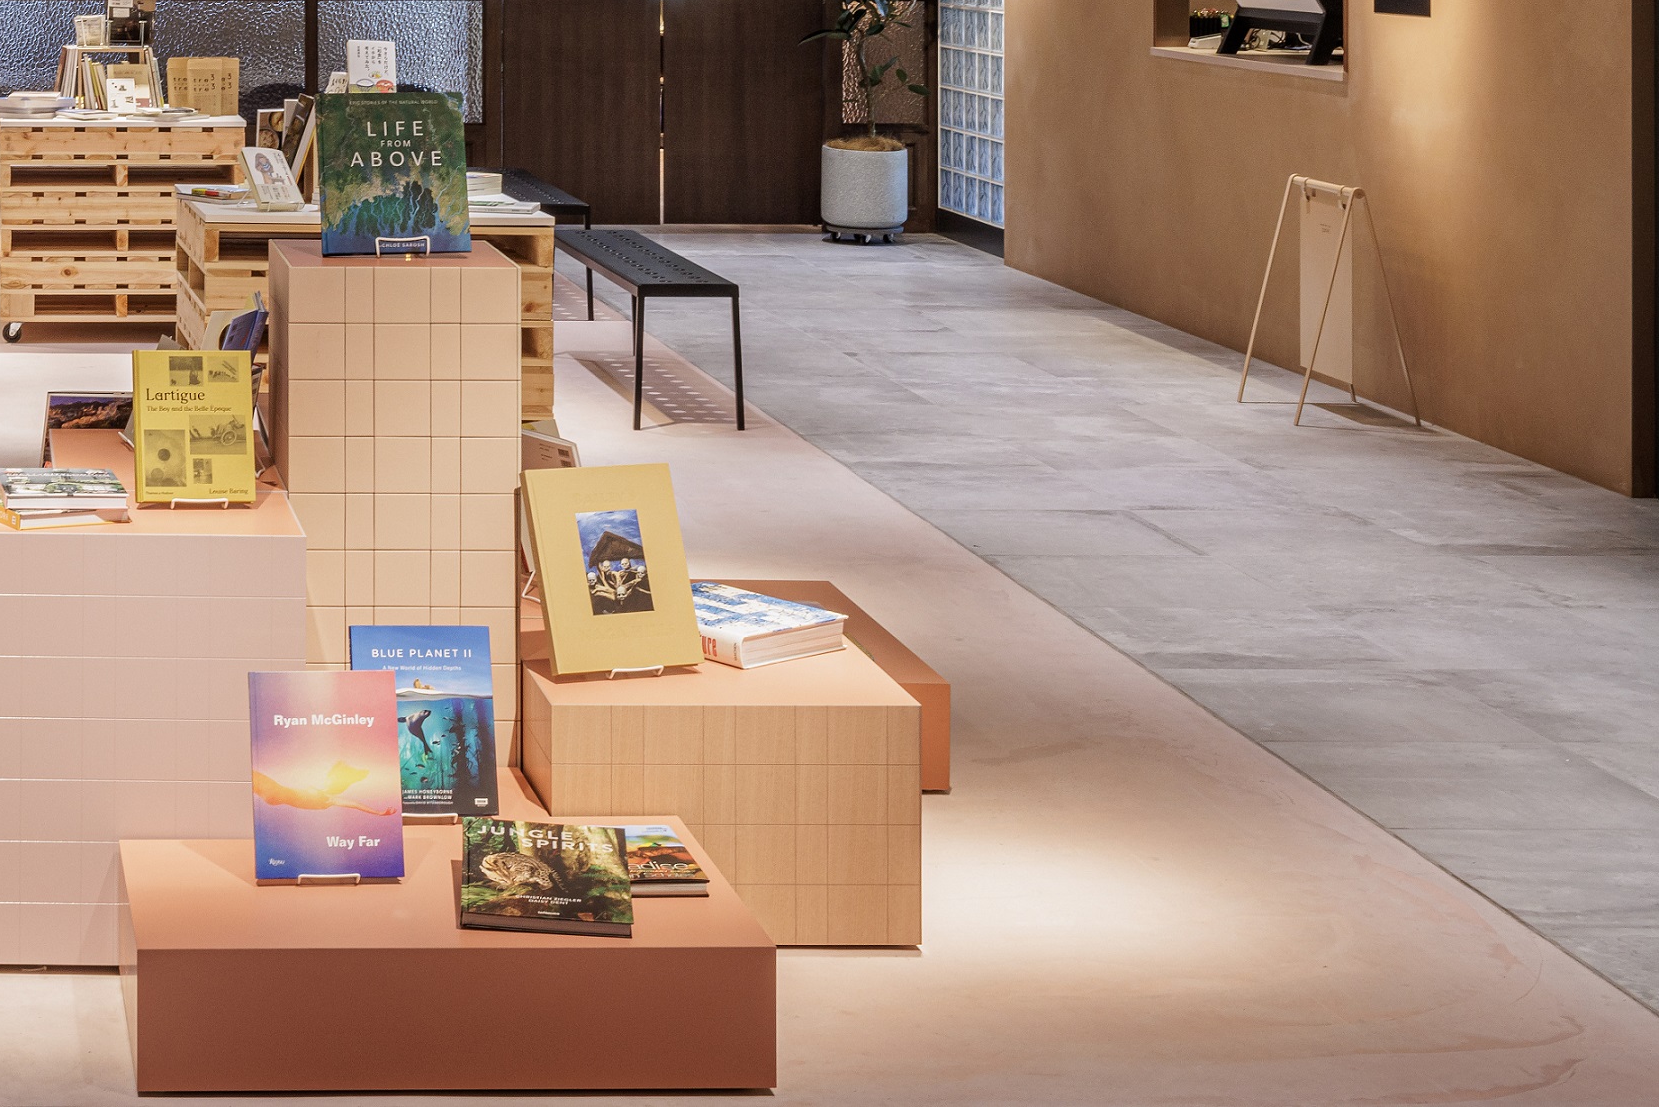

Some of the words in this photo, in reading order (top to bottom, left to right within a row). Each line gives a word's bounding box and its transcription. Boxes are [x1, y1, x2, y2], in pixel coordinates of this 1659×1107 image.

[366, 120, 424, 137] LIFE
[380, 139, 411, 147] FROM
[350, 150, 442, 167] ABOVE
[146, 388, 205, 404] Lartigue
[371, 648, 404, 658] BLUE
[409, 648, 458, 658] PLANET
[463, 648, 472, 658] II
[701, 635, 718, 657] ure
[273, 714, 308, 729] Ryan
[311, 714, 375, 728] McGinley
[477, 825, 574, 841] JUNGLE
[326, 836, 355, 850] Way
[358, 836, 381, 847] Far
[521, 839, 614, 853] SPIRITS
